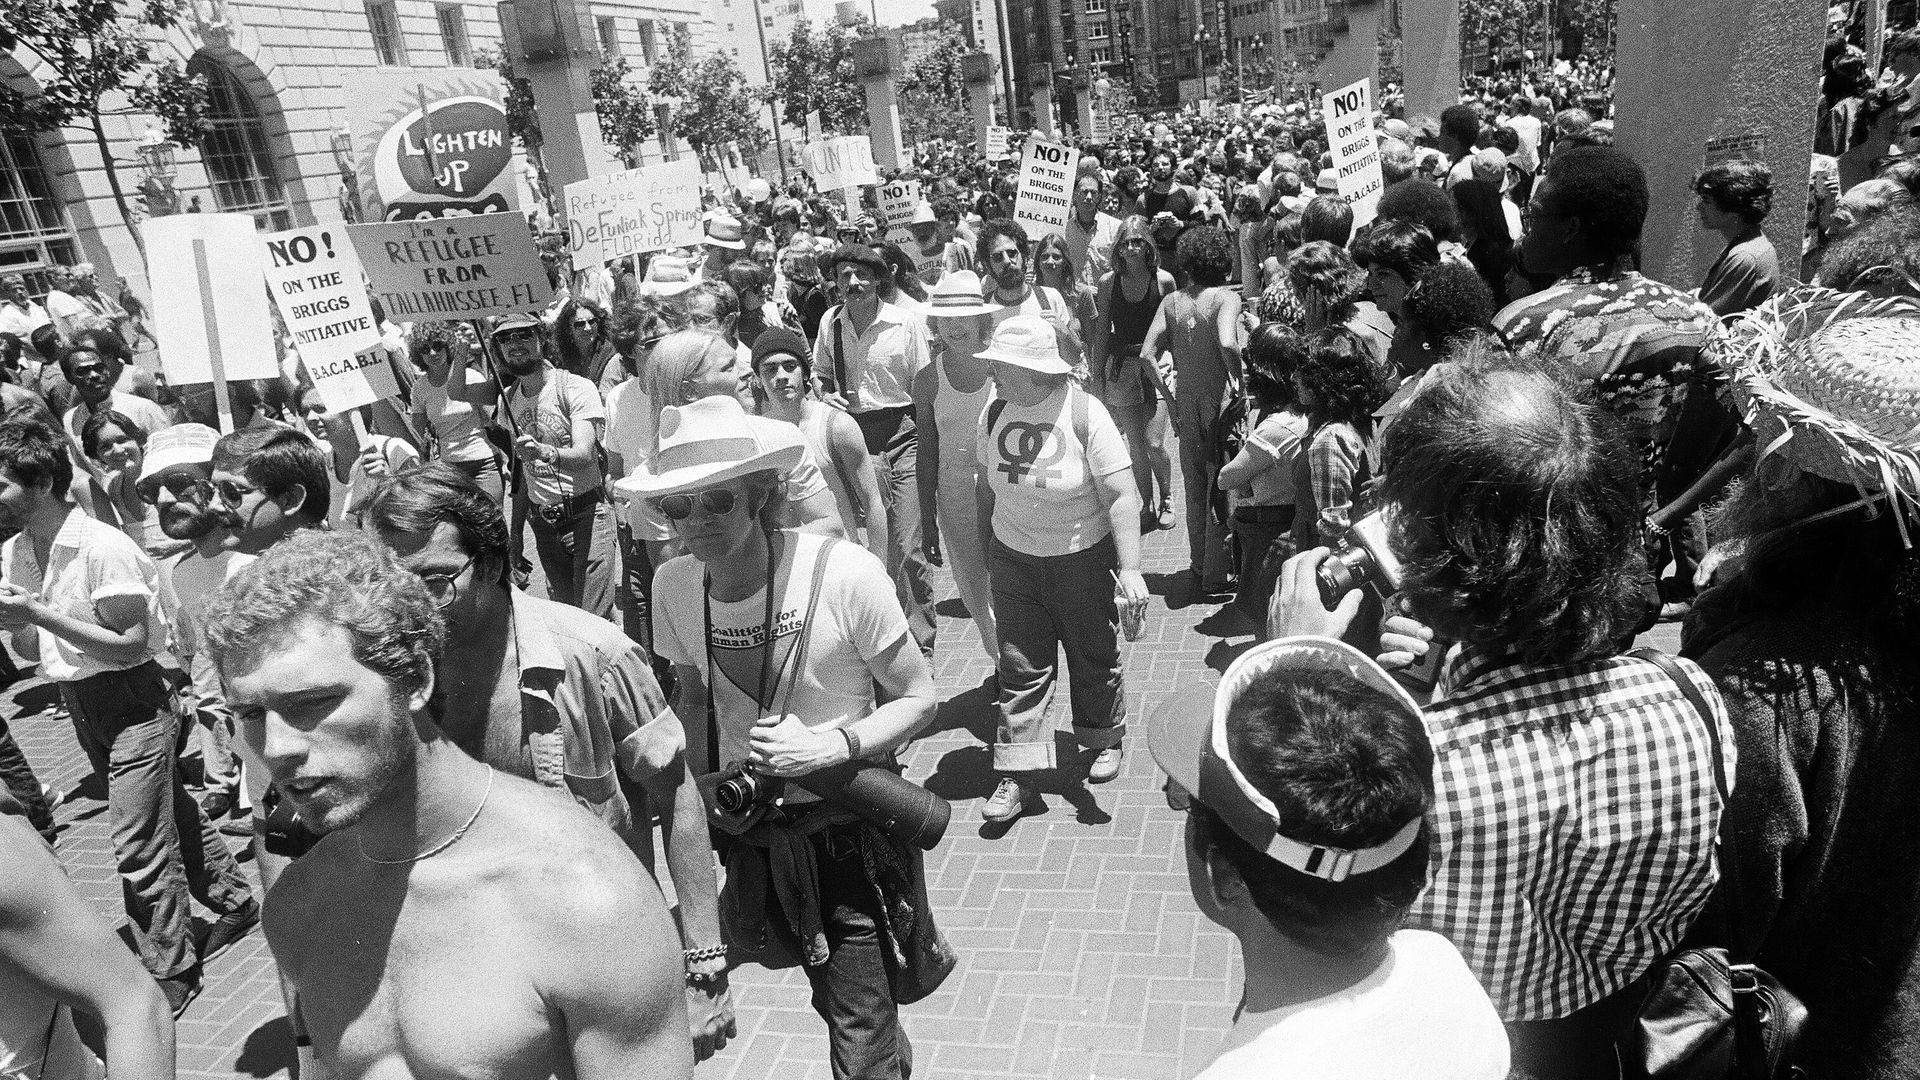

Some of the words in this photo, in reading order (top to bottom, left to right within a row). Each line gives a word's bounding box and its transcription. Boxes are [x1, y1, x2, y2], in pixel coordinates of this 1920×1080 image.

[1333, 87, 1365, 118] NO!
[1337, 126, 1352, 139] ON
[1354, 117, 1367, 132] THE
[402, 129, 502, 156] LIGHTEN
[1341, 136, 1370, 157] BRIGGS
[1033, 144, 1070, 166] NO!
[1338, 151, 1378, 179] INITIATIVE
[433, 160, 469, 192] UP
[634, 169, 645, 178] A
[1031, 165, 1045, 176] ON
[1047, 168, 1066, 180] THE
[882, 185, 911, 200] NO!
[1029, 179, 1064, 193] BRIGGS
[571, 191, 634, 215] Refugee
[648, 181, 688, 197] from
[885, 203, 896, 211] ON
[896, 201, 912, 209] THE
[1020, 190, 1069, 207] INITIATIVE
[650, 202, 703, 234] Springs
[887, 210, 914, 221] BRIGGS
[408, 223, 435, 239] I'm
[446, 225, 457, 235] a
[267, 231, 335, 267] NO!
[384, 234, 501, 264] REFUGEE
[282, 279, 304, 295] ON
[307, 271, 343, 291] THE
[422, 263, 491, 285] FROM
[511, 283, 540, 305] FL
[291, 295, 350, 319] BRIGGS
[295, 316, 370, 344] INITIATIVE
[711, 623, 766, 637] Coalitio
[775, 608, 798, 624] for
[711, 636, 750, 647] uman
[752, 620, 803, 644] Rghts
